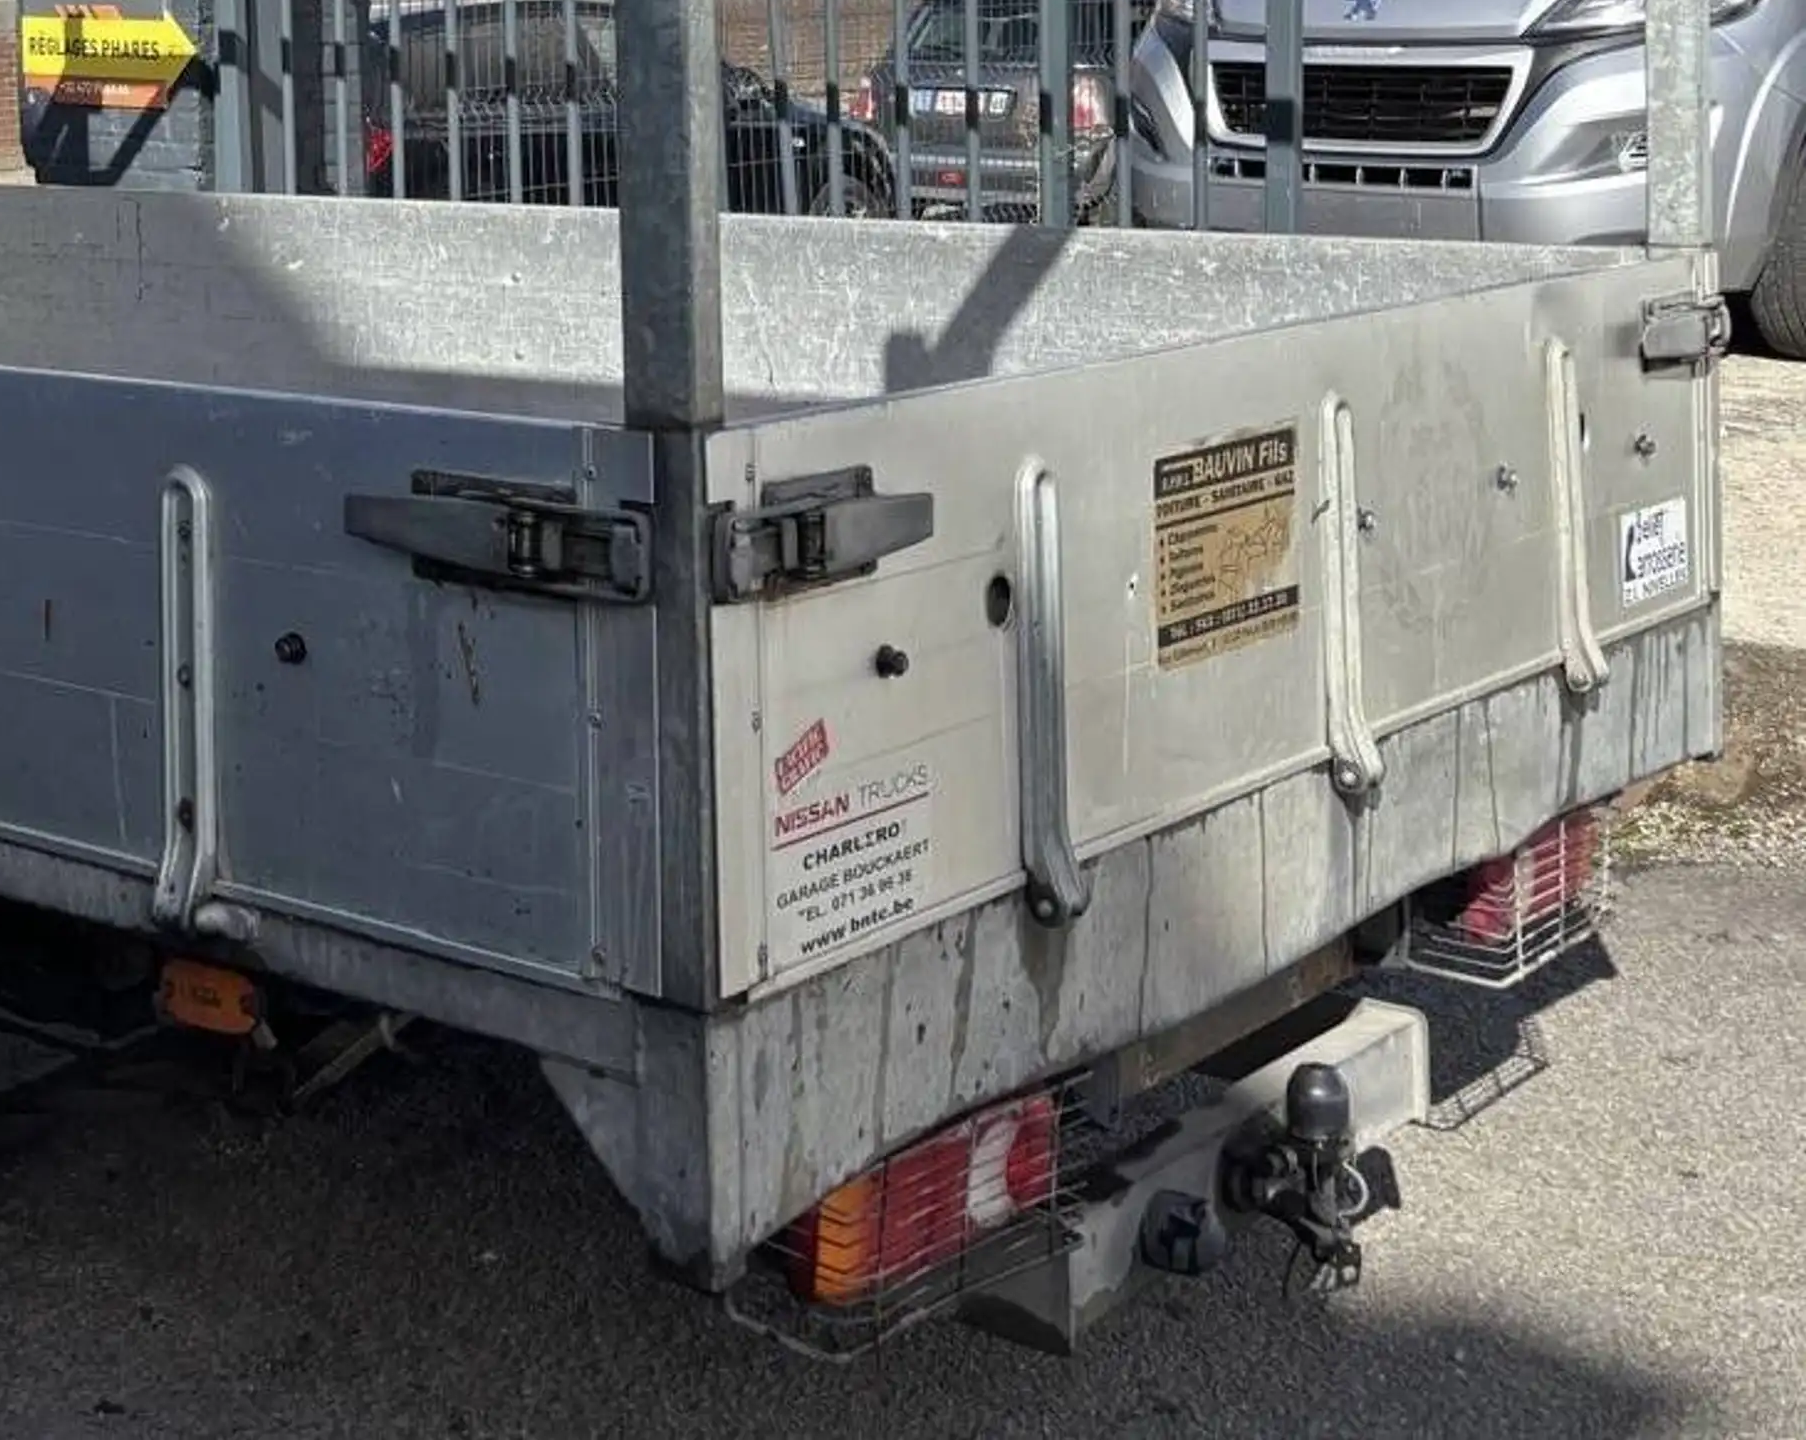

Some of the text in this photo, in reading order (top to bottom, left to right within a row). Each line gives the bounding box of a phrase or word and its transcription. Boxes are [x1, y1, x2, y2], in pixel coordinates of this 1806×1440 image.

[102, 39, 161, 61] PHARES
[1192, 444, 1255, 481] BAUVIN
[774, 792, 851, 838] NISSAN
[776, 837, 930, 910] GARAGE BOUCKAERT
